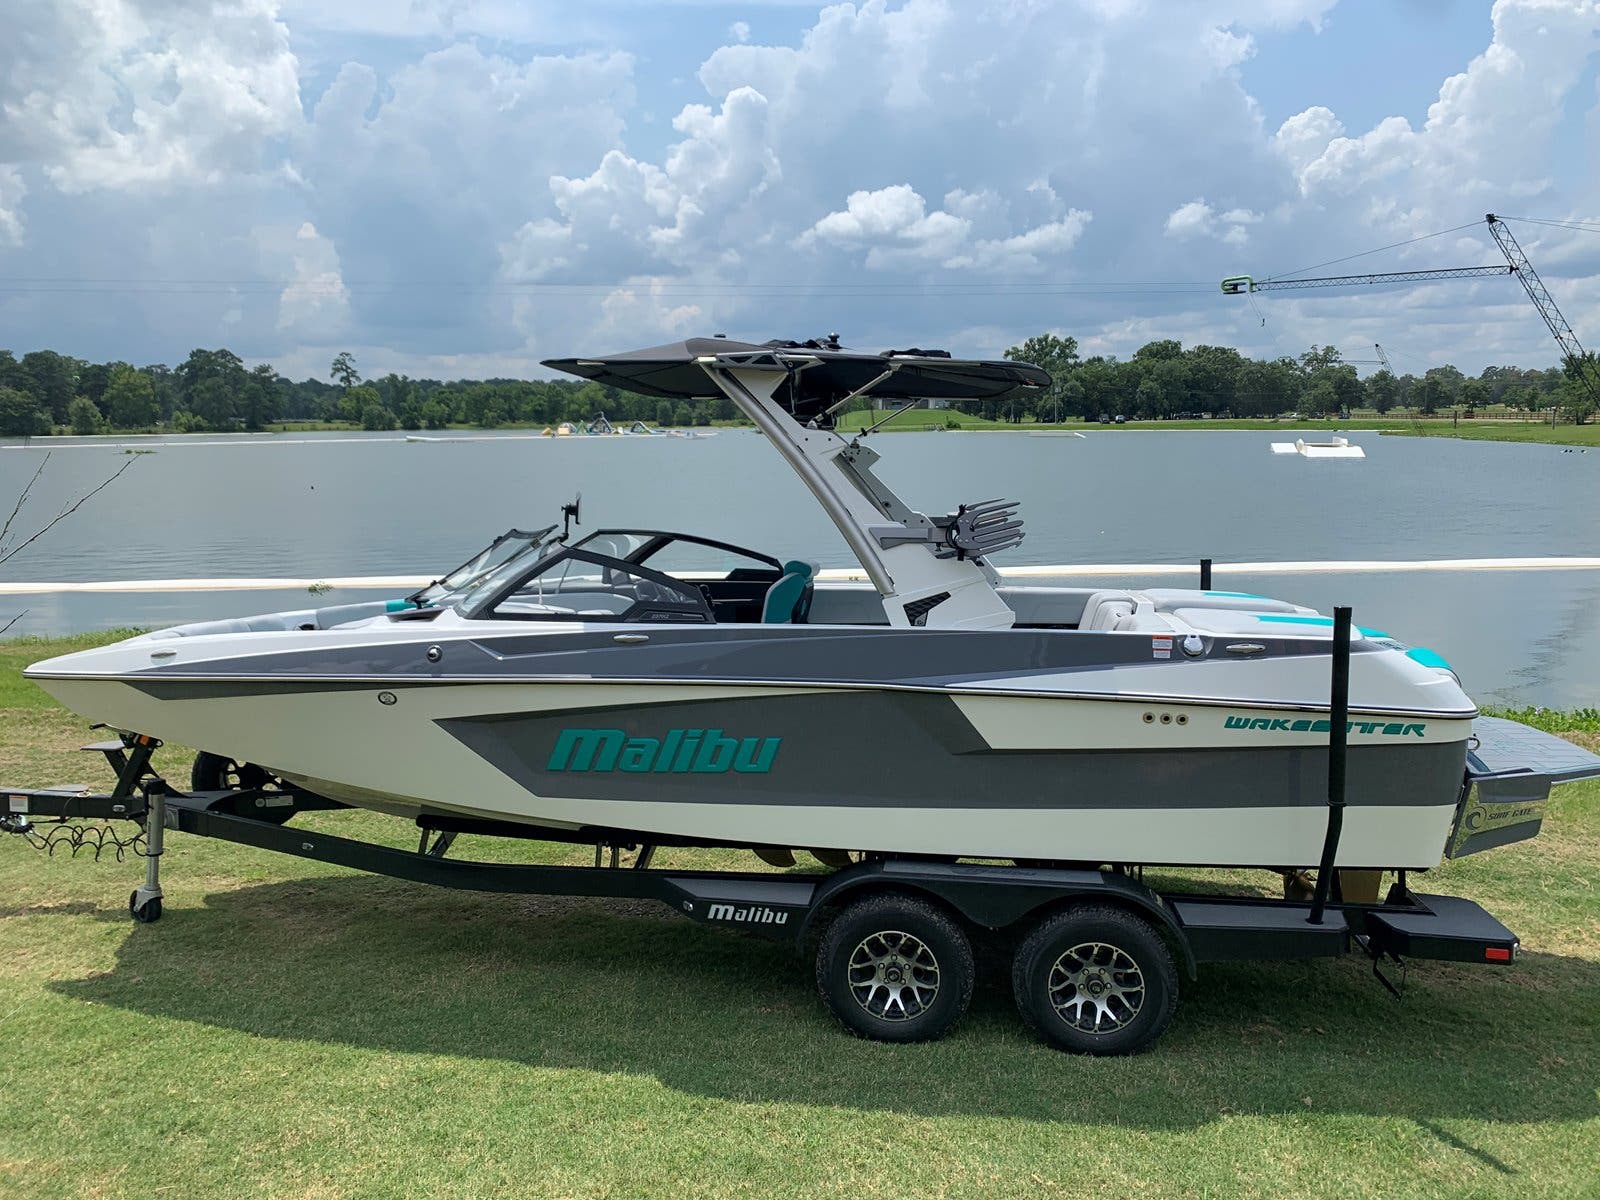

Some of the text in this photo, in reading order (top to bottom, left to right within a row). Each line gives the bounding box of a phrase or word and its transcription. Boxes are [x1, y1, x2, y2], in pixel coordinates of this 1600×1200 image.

[545, 728, 783, 774] Malibu
[1487, 811, 1511, 821] SURF
[707, 904, 788, 925] Malibu
